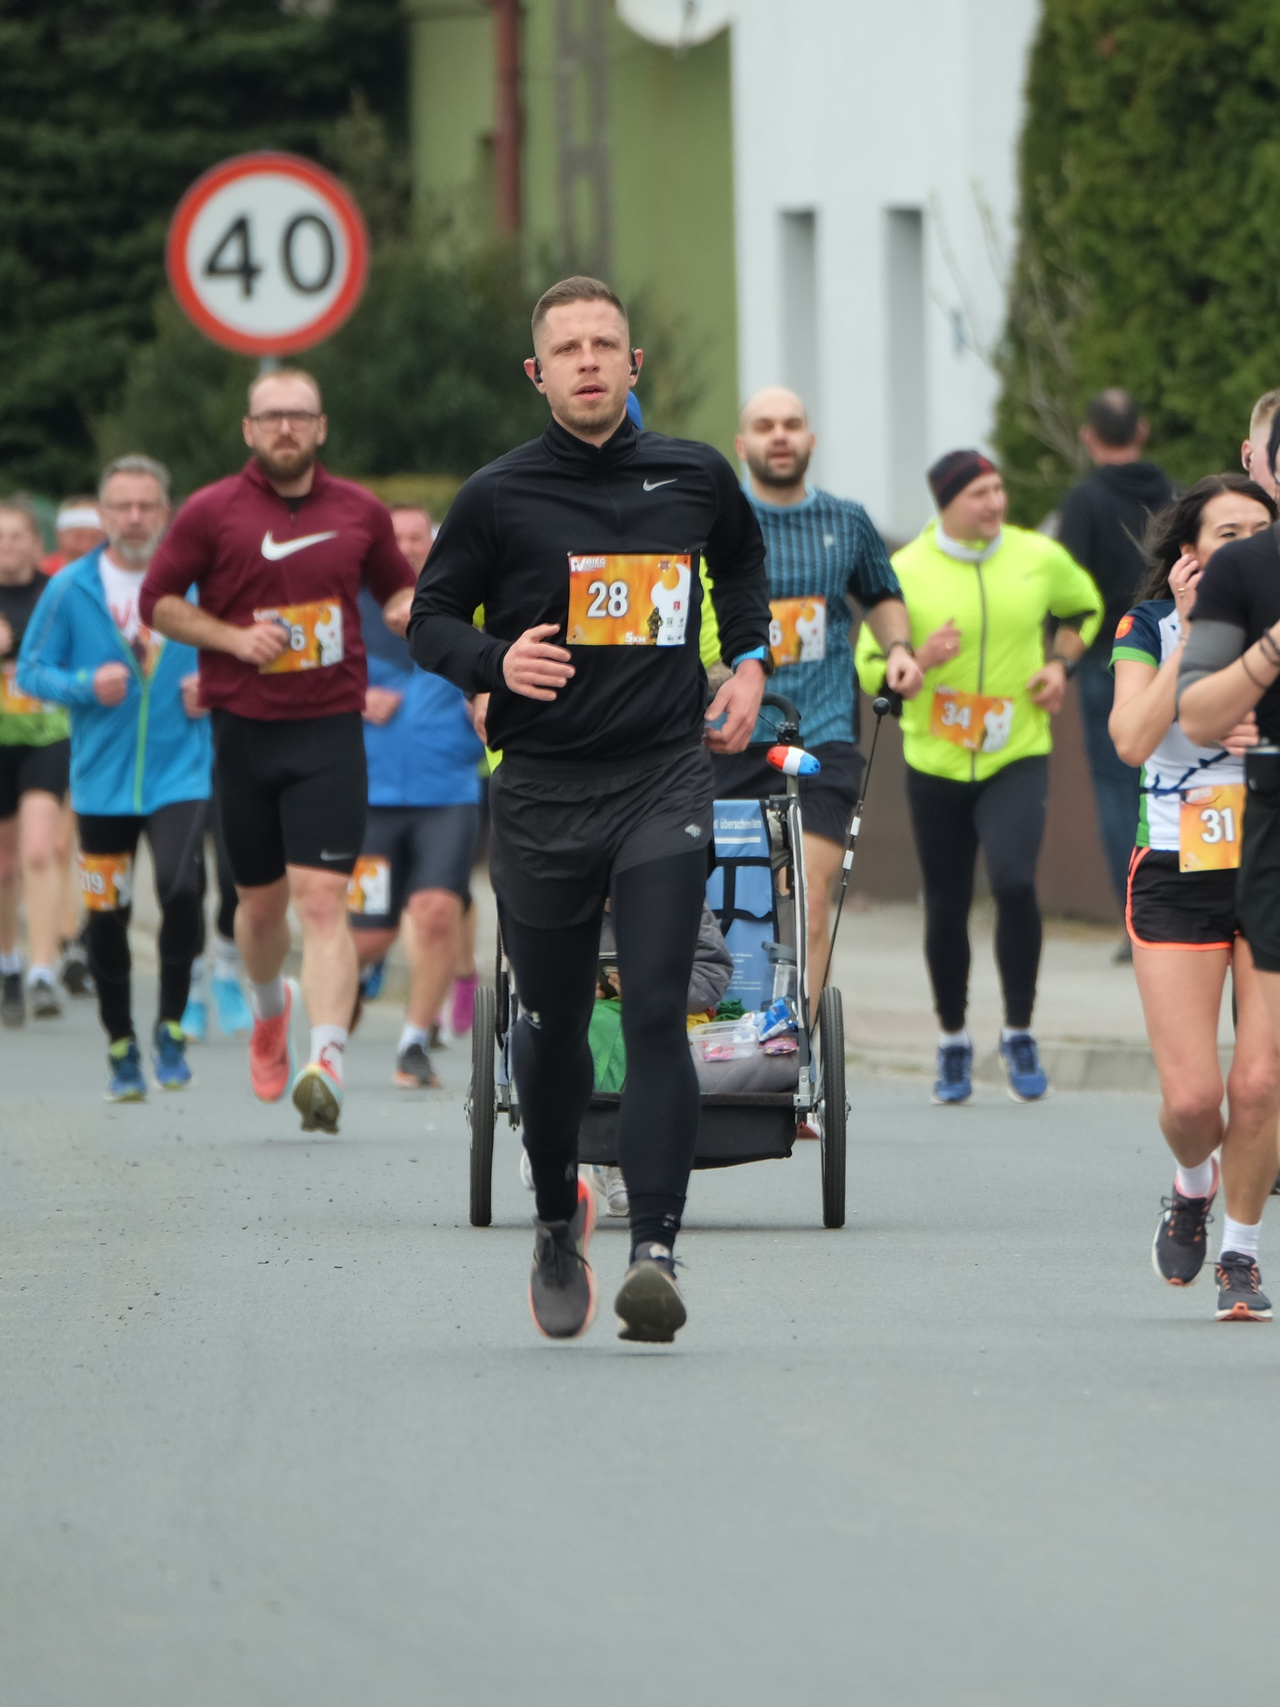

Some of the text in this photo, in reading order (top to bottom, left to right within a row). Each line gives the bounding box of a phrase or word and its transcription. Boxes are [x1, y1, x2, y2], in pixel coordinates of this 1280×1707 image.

[204, 213, 335, 297] 40
[587, 581, 628, 618] 28
[941, 702, 972, 729] 34
[1200, 807, 1235, 843] 31
